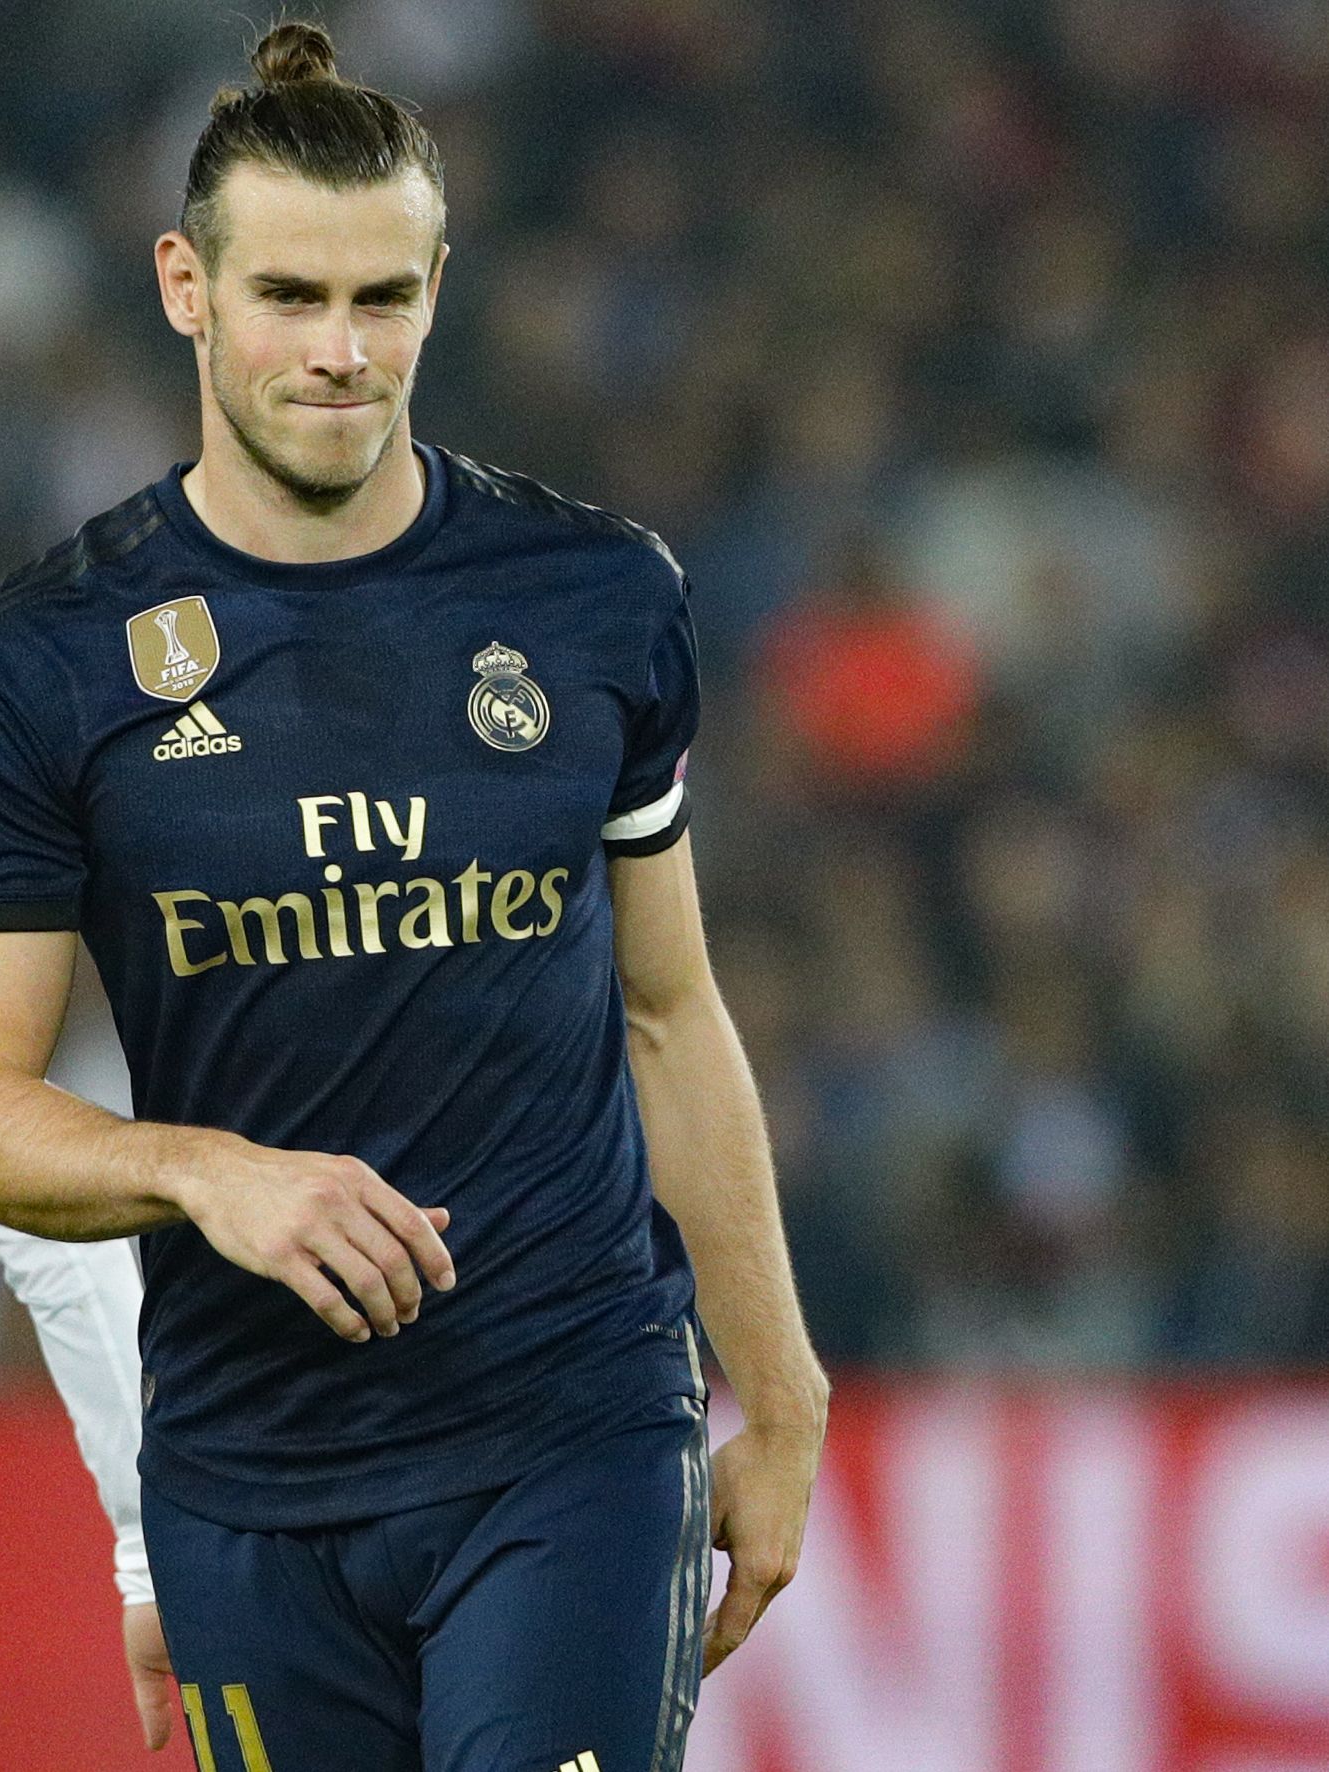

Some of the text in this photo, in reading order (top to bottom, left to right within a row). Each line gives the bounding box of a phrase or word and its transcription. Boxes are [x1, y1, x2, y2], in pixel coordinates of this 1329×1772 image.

[161, 660, 198, 682] FIFA
[153, 734, 241, 761] adidas
[297, 792, 426, 861] Fly
[151, 858, 568, 976] Emirates
[180, 1684, 272, 1772] 11
